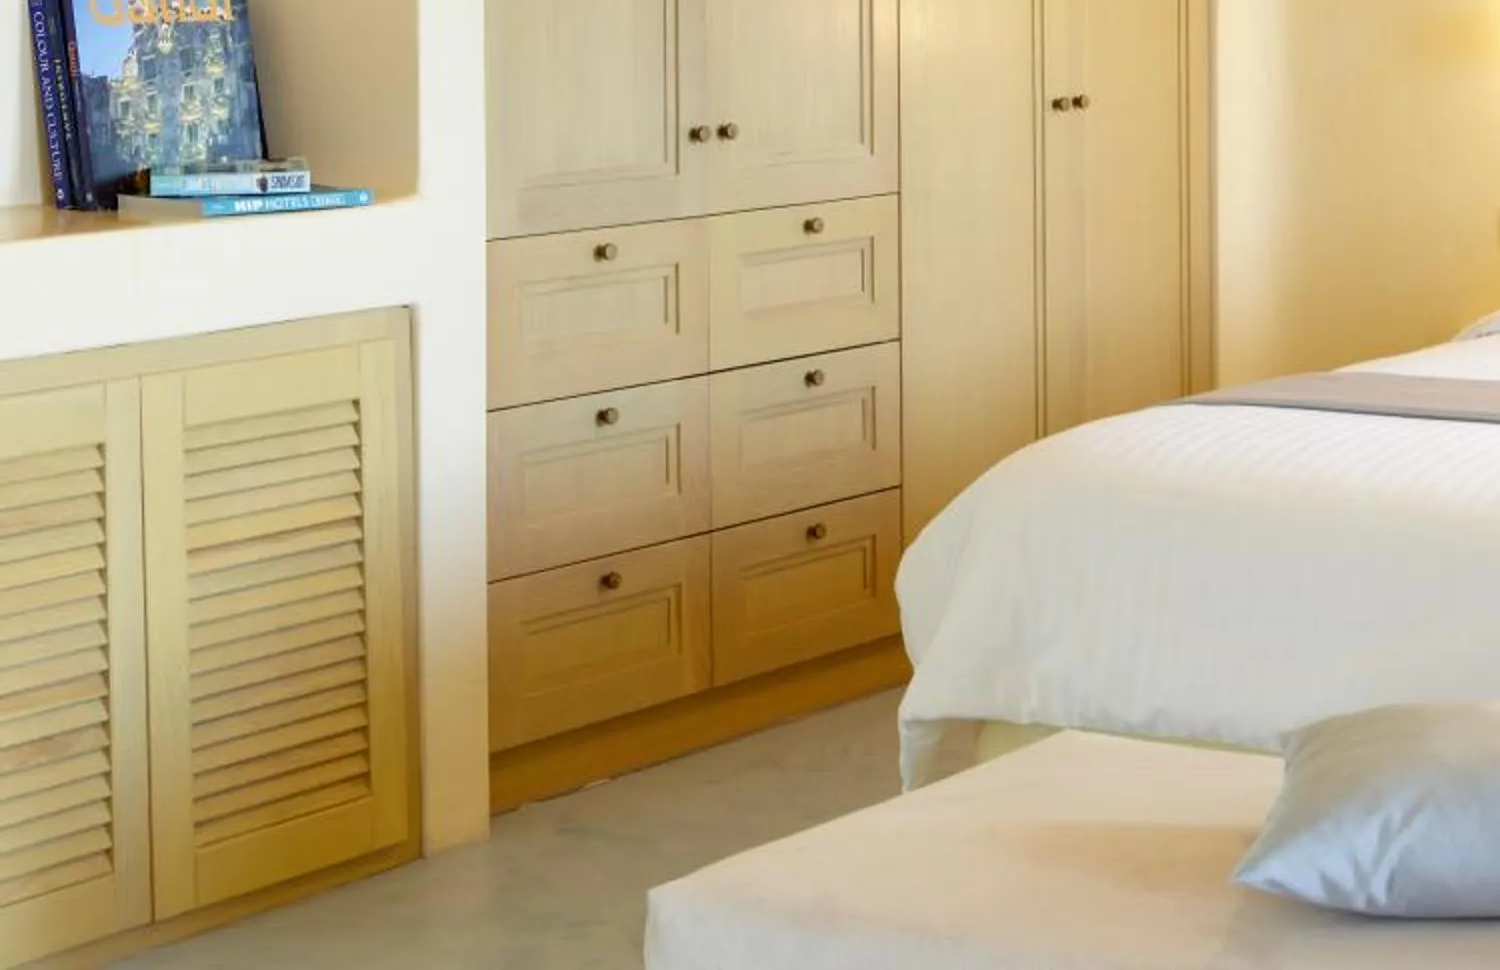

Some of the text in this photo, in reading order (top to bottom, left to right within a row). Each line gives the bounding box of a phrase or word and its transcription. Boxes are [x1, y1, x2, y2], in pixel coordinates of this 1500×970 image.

[33, 11, 49, 72] COLOUR
[41, 75, 54, 110] AND
[47, 112, 62, 180] CULTURE
